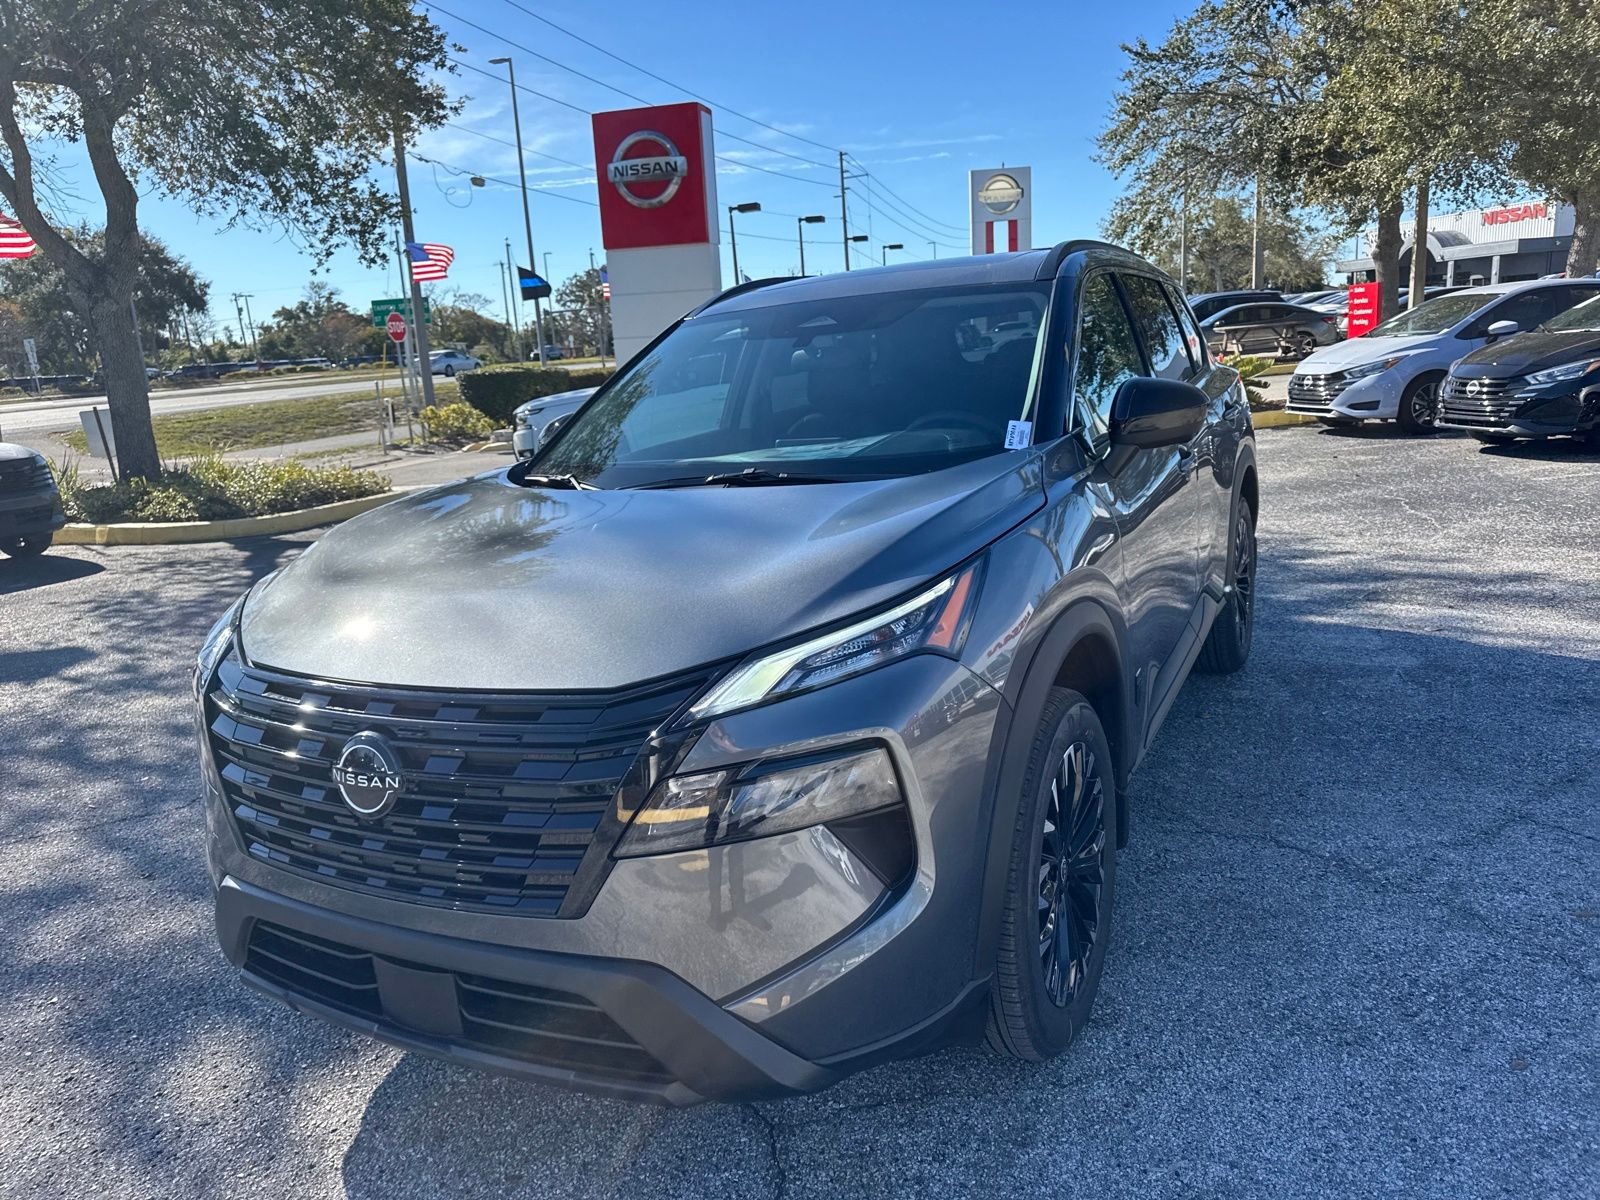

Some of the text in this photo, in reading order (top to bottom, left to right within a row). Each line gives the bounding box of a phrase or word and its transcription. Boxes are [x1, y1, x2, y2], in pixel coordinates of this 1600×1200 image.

[614, 161, 678, 177] NISSAN
[1481, 204, 1548, 226] NISSAN
[388, 321, 405, 333] STOP
[332, 768, 399, 788] NISSAN
